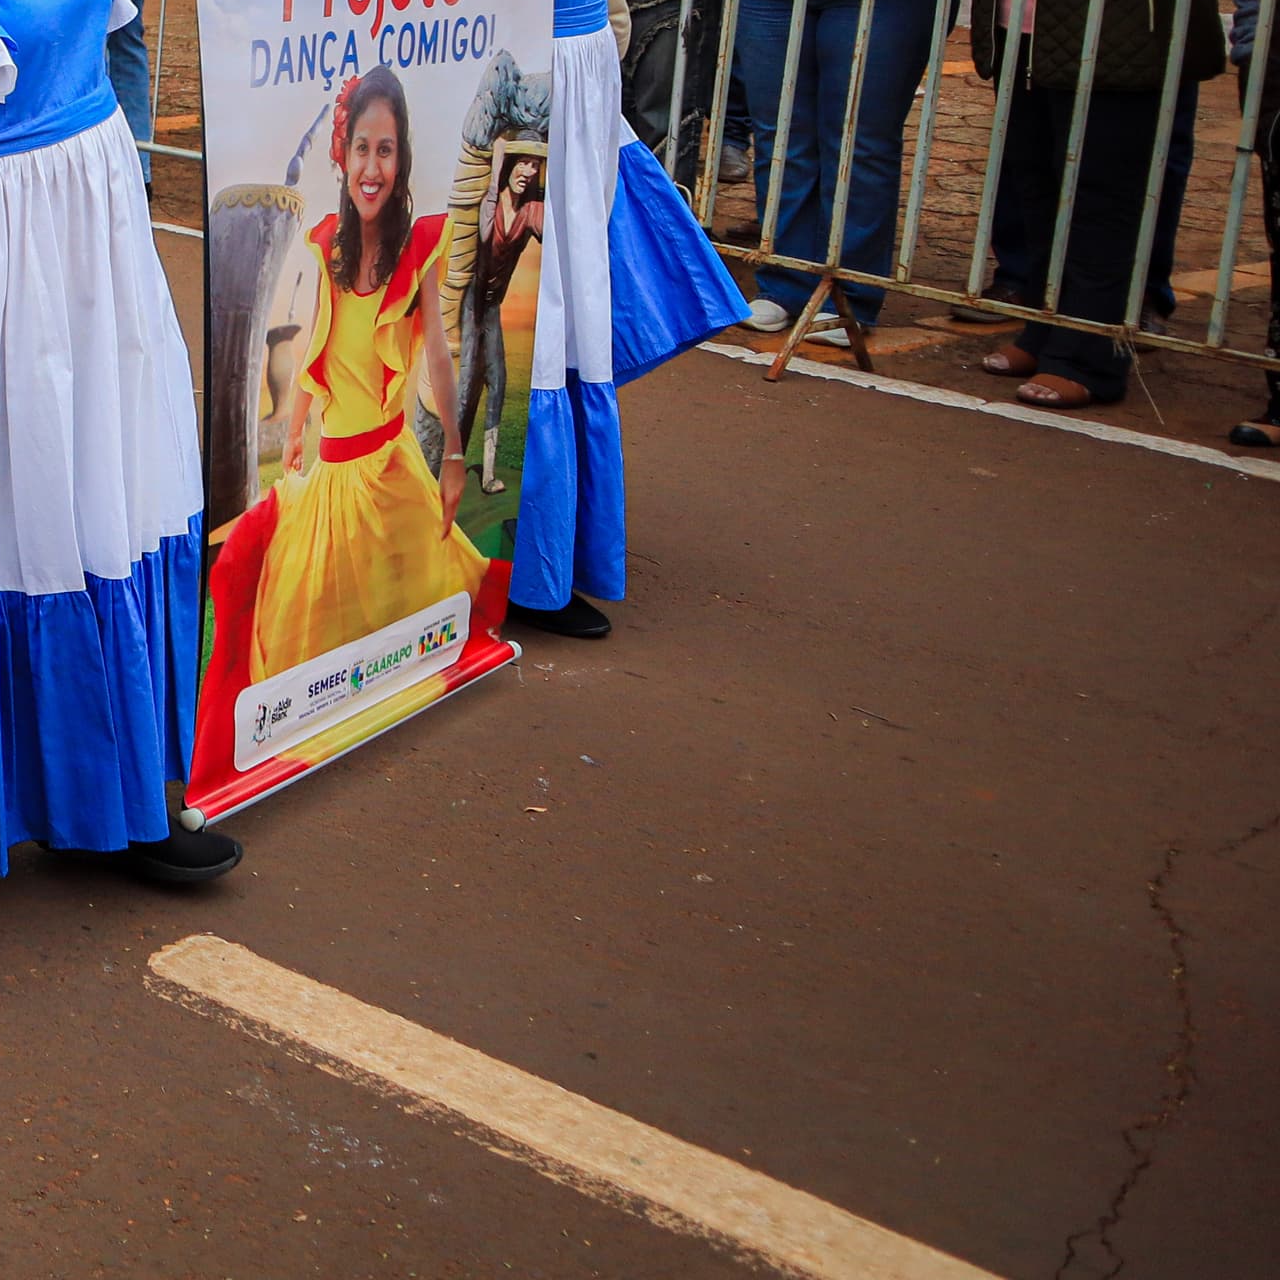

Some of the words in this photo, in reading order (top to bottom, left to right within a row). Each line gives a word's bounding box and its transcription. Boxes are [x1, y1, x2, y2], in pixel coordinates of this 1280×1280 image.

[250, 28, 360, 92] DANÇA
[378, 13, 496, 68] COMIGO!
[365, 640, 413, 678] CAARAPÓ
[308, 668, 347, 698] SEMEEC
